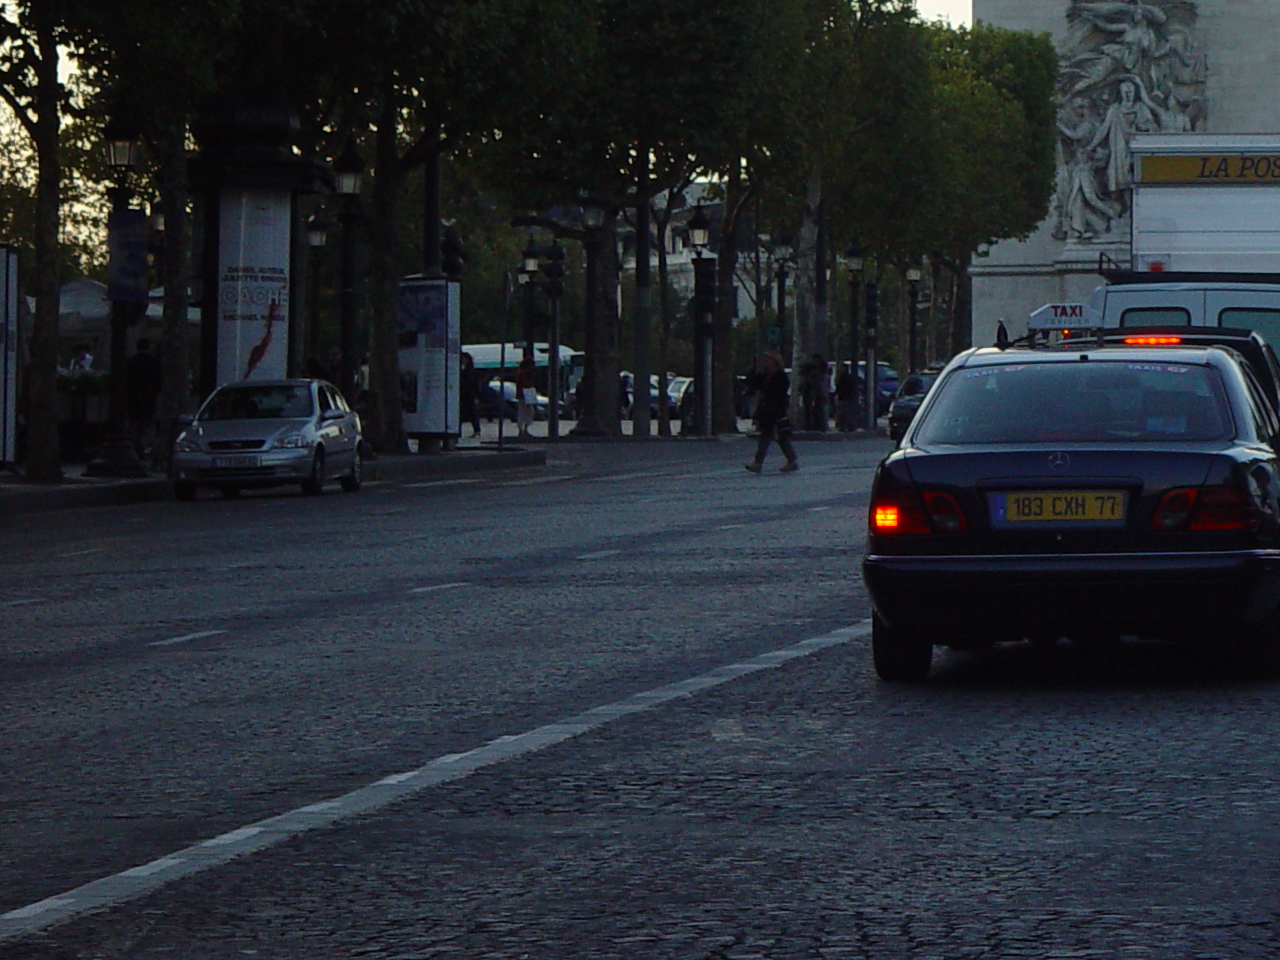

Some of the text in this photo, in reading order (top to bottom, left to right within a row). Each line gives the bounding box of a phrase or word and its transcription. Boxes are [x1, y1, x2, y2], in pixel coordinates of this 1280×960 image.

[1197, 157, 1230, 179] LA
[1050, 305, 1083, 318] TAXI
[1013, 497, 1044, 517] 183
[1052, 496, 1086, 516] CXH
[1094, 496, 1117, 516] 77
